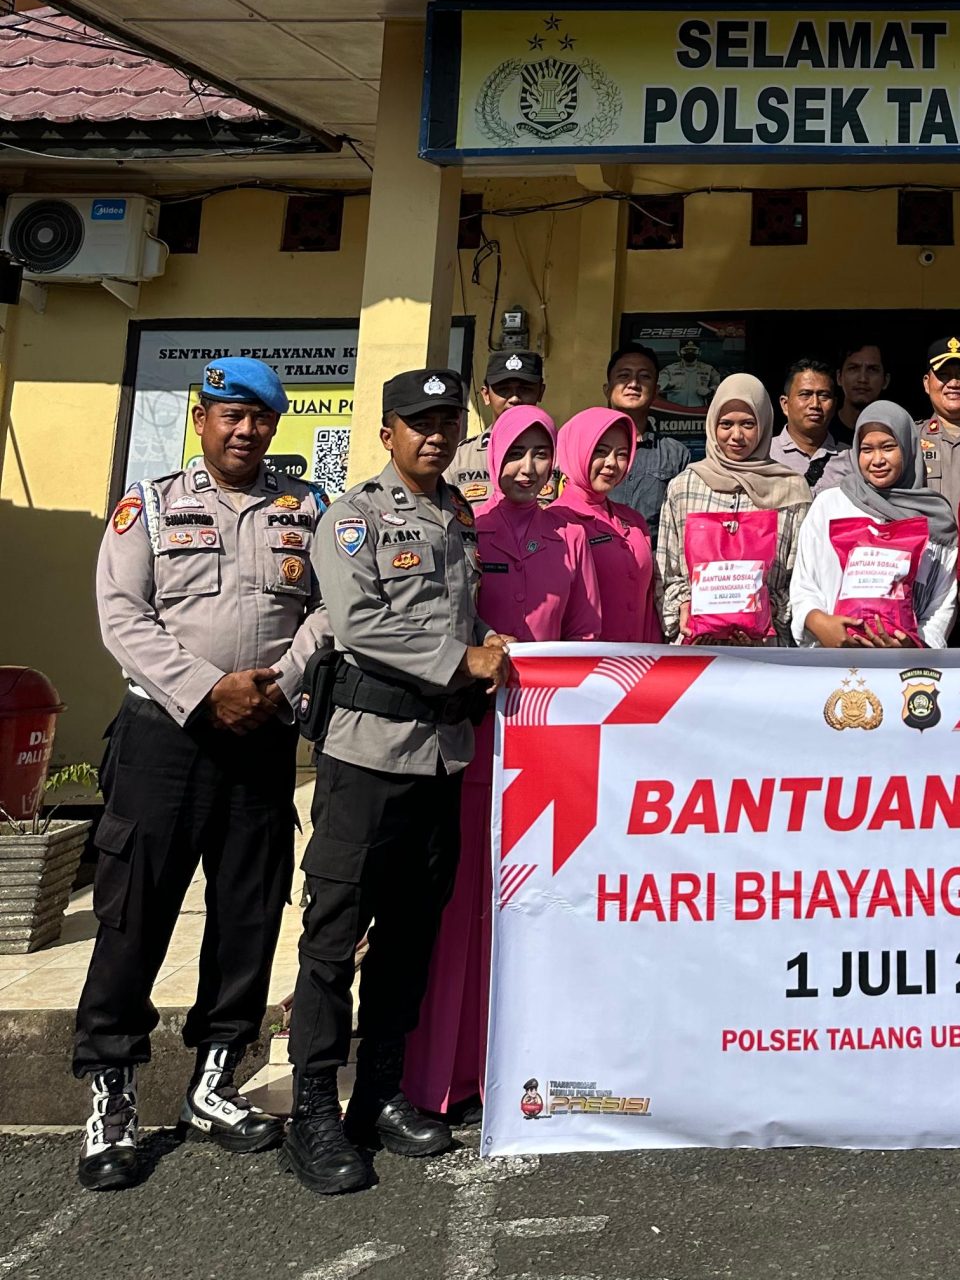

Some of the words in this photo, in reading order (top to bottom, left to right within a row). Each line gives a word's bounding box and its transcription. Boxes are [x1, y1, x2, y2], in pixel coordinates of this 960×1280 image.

[676, 20, 947, 69] SELAMAT
[643, 86, 870, 144] POLSEK
[159, 348, 232, 359] SENTRAL
[240, 348, 335, 359] PELAYANAN
[285, 365, 348, 375] TALANG
[285, 465, 303, 474] 110
[17, 750, 42, 765] PALI
[597, 872, 716, 922] HARI
[786, 951, 818, 998] 1
[832, 949, 937, 997] JULI
[722, 1028, 819, 1052] POLSEK
[826, 1026, 922, 1051] TALANG
[551, 1096, 651, 1112] PRESISI
